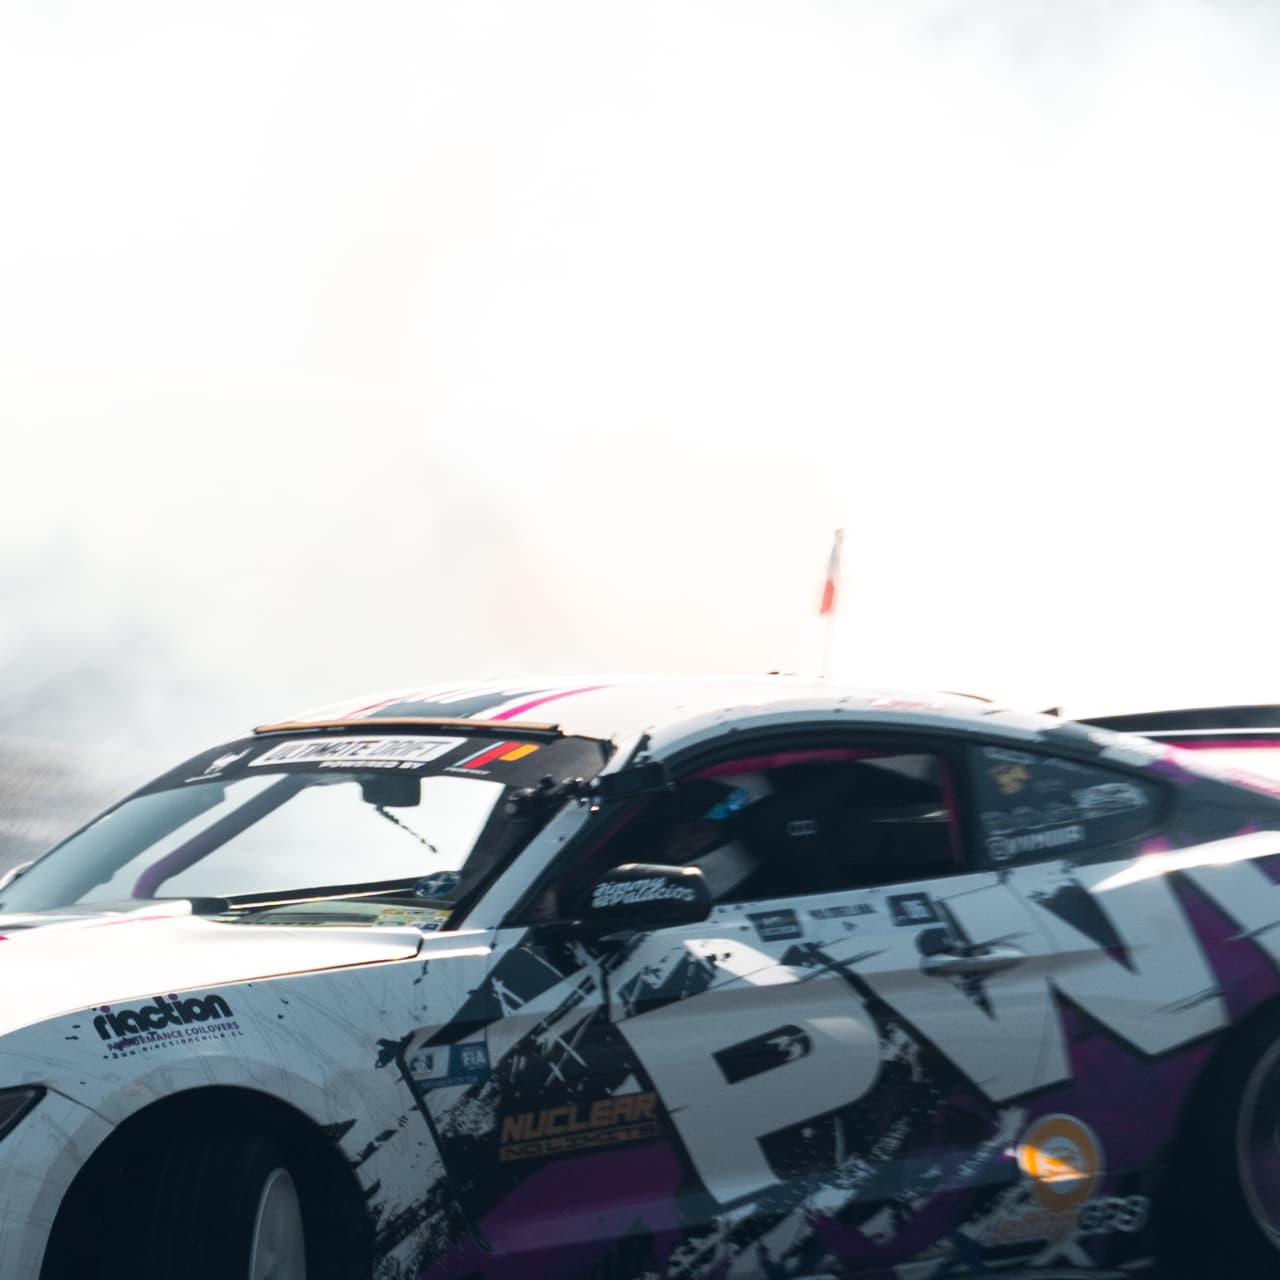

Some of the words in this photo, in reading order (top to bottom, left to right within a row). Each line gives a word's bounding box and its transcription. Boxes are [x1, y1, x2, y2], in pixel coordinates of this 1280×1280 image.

[360, 741, 452, 759] DRIFT
[93, 993, 234, 1040] riaction
[185, 1021, 240, 1036] COILOVERS
[501, 1092, 658, 1142] NUCLEAR
